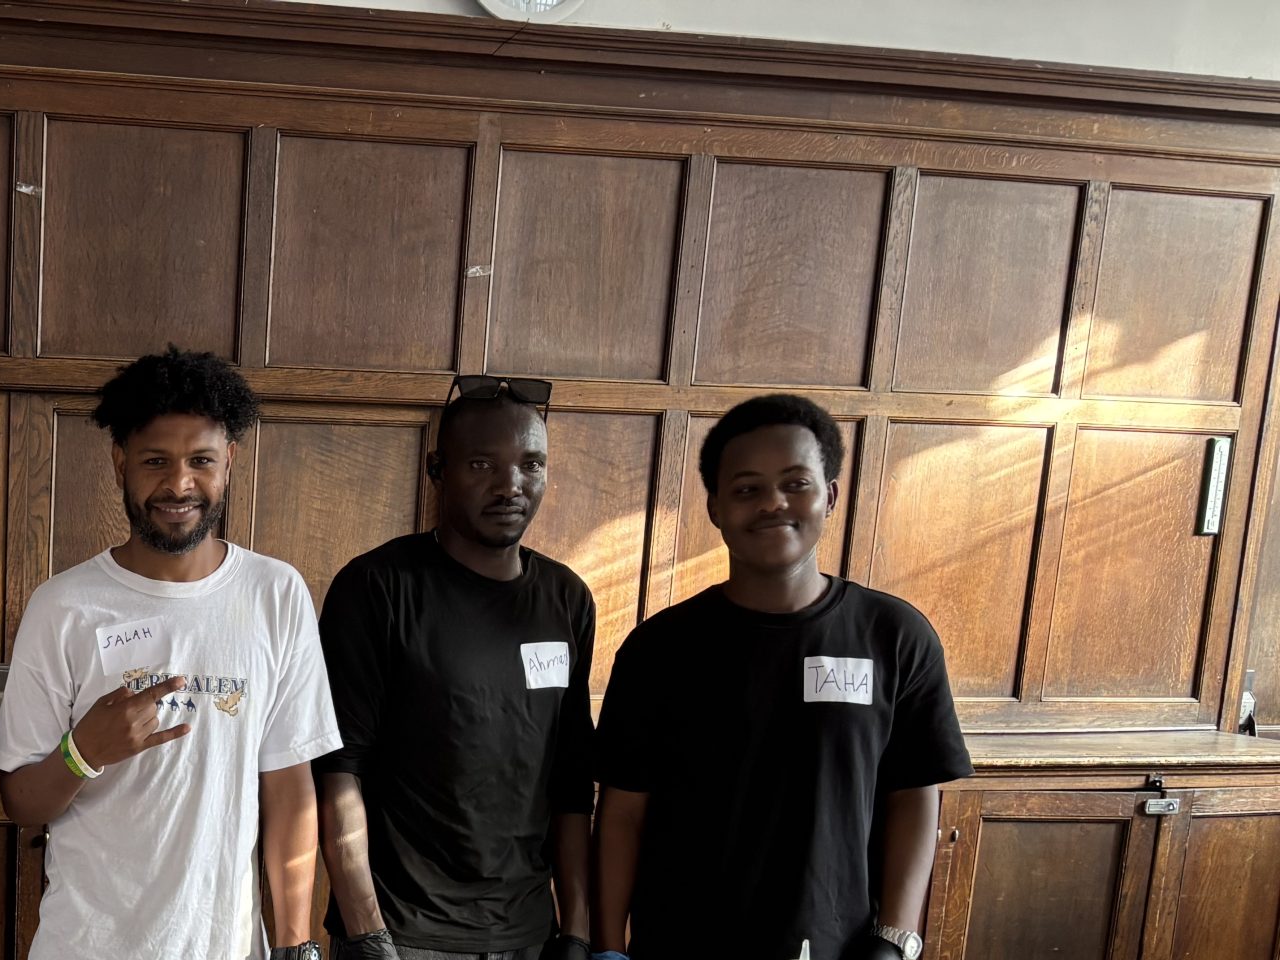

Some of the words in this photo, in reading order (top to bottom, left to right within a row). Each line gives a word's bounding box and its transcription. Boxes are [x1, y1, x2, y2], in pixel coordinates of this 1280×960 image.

[103, 627, 153, 649] SALAH
[122, 671, 248, 697] ERALEM
[807, 665, 868, 694] TAHA
